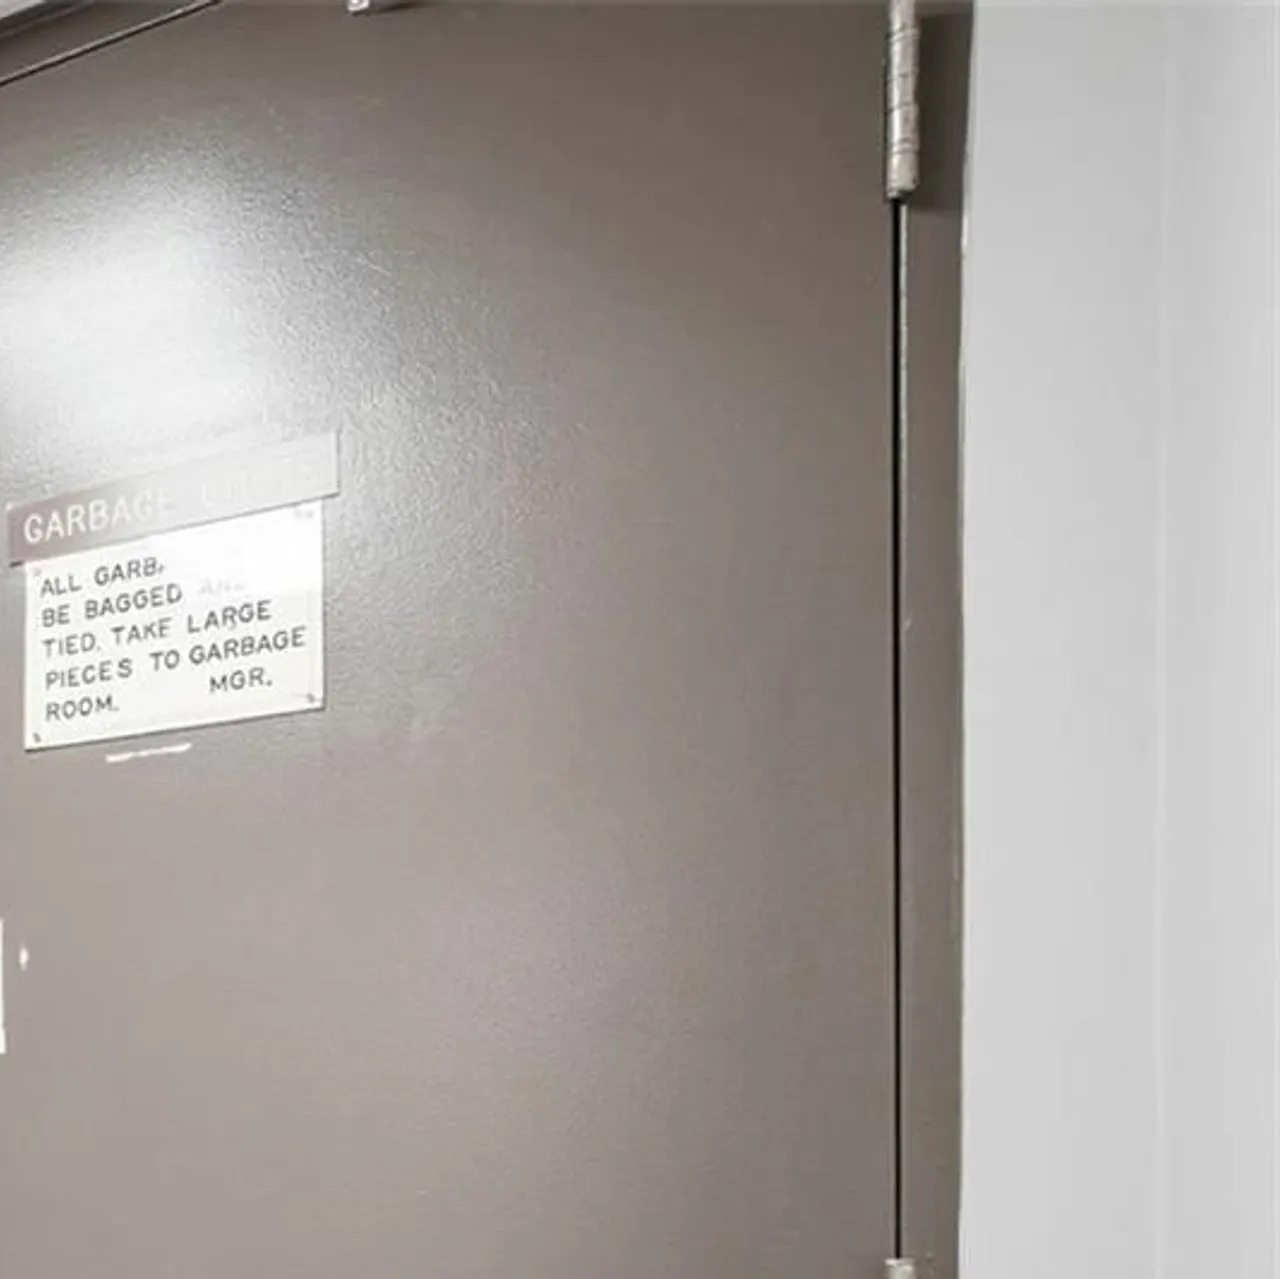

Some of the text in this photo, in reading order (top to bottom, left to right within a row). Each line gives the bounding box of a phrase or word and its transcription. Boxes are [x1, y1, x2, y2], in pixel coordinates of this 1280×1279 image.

[40, 556, 167, 598] ALL GARB
[41, 604, 72, 628] BE
[84, 582, 183, 621] BAGGED
[111, 617, 173, 646] TAKE
[187, 599, 273, 634] LARGE
[45, 625, 307, 690] PIECES TO GARBAGE
[44, 666, 274, 722] ROOM. MGR.
